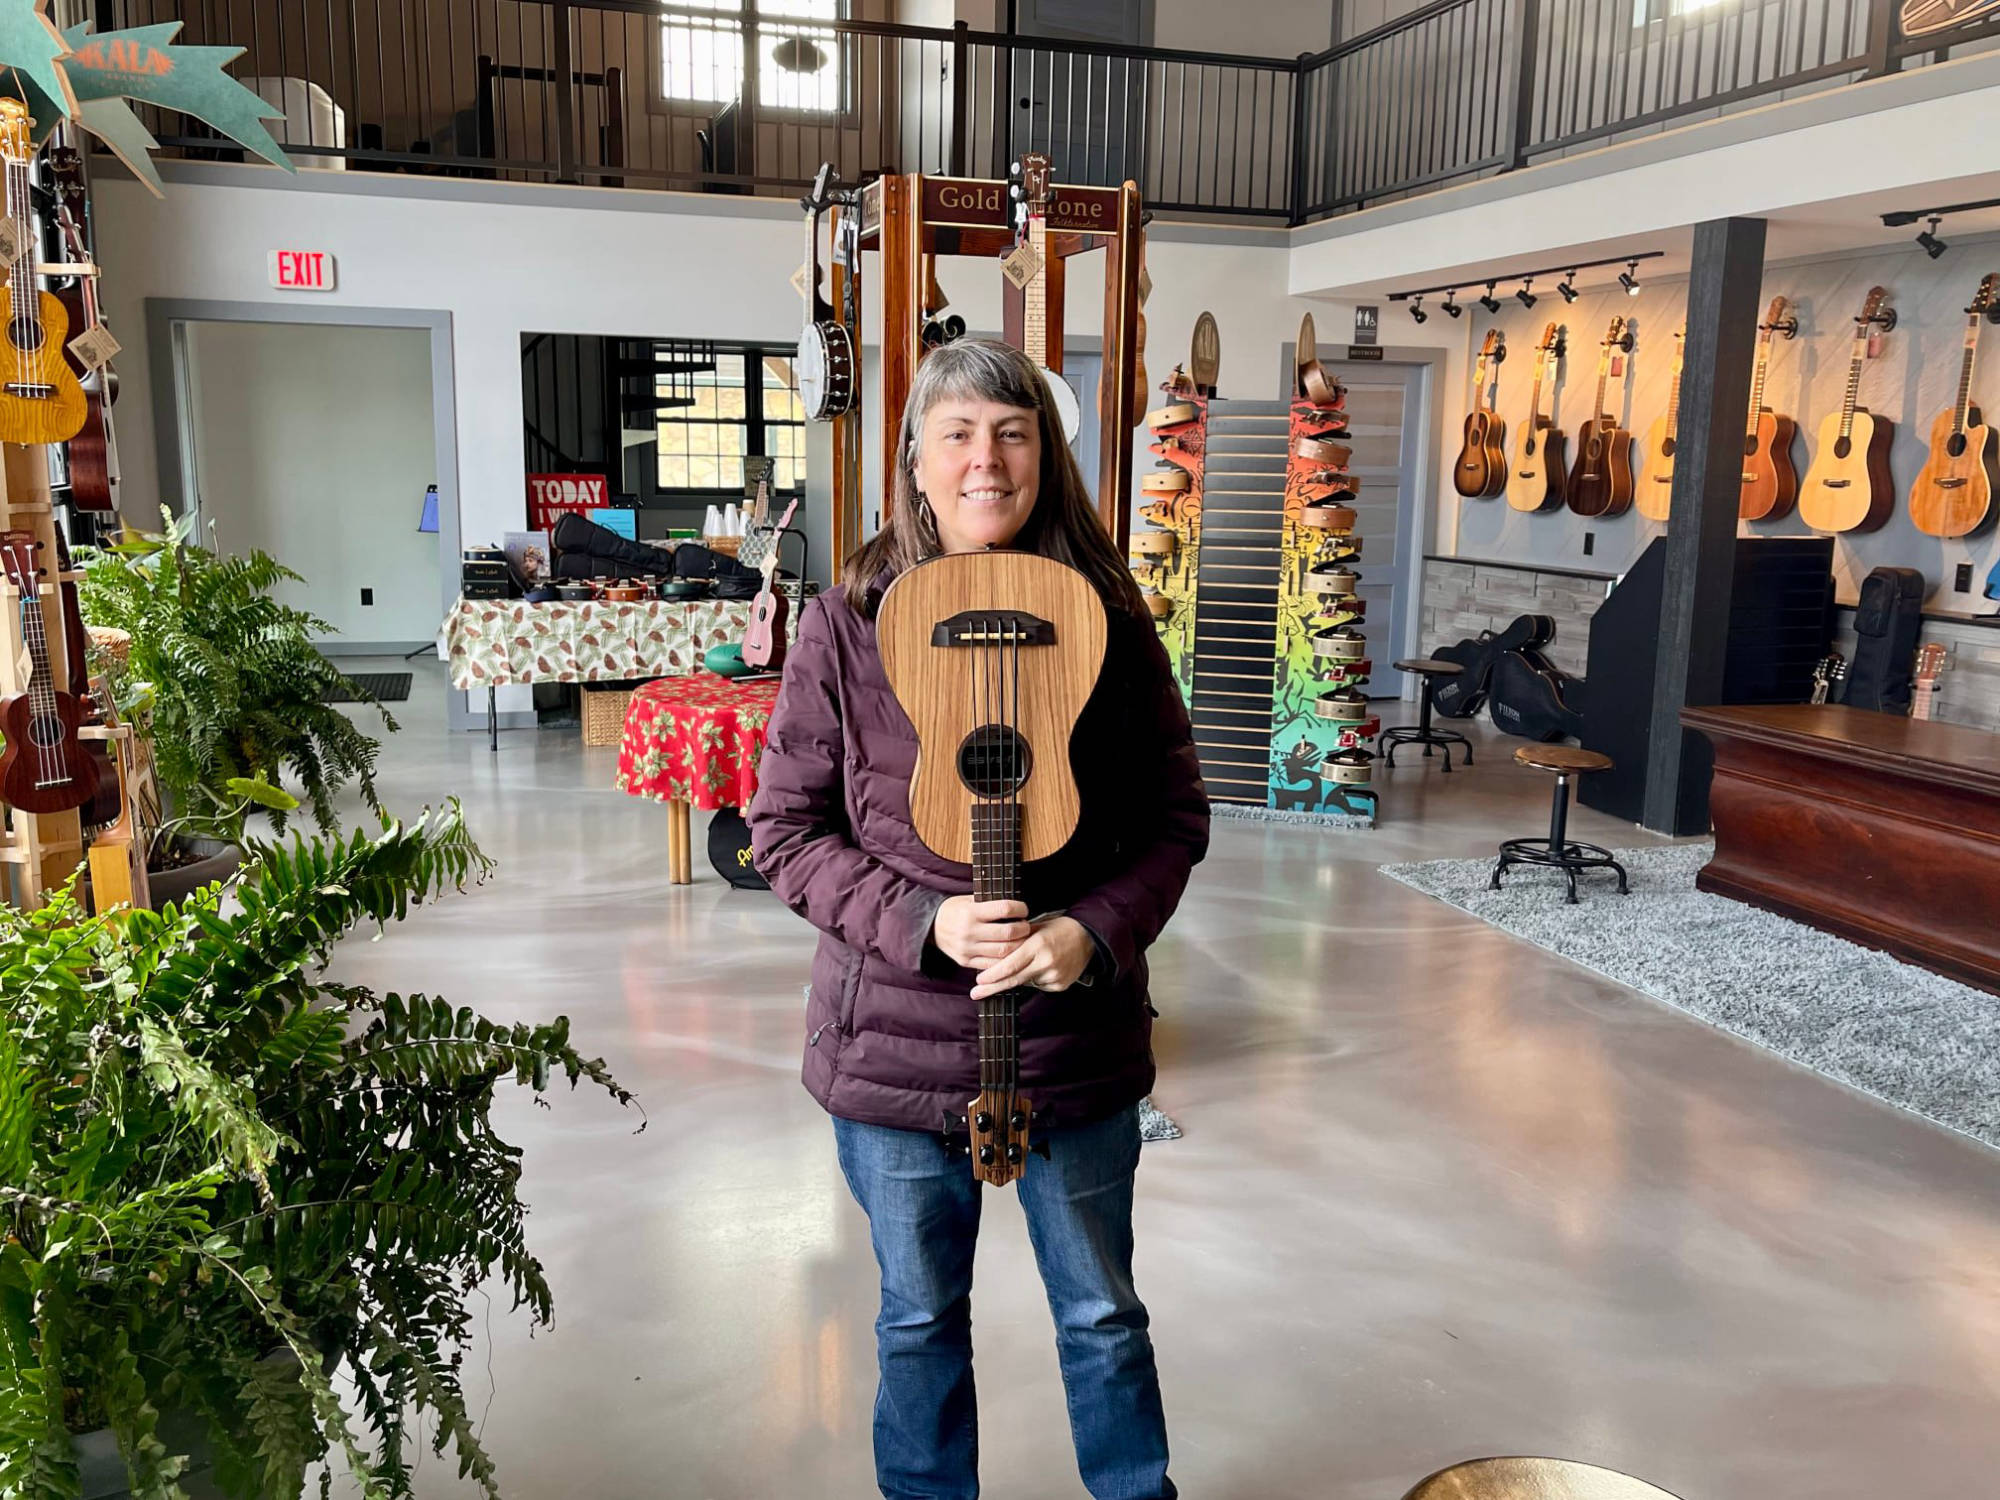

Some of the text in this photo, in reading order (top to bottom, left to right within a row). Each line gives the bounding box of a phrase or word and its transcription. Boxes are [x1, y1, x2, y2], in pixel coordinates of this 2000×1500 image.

[80, 38, 168, 77] KALA
[939, 186, 1000, 212] Gold
[278, 252, 323, 287] EXIT
[532, 480, 602, 504] TODAY
